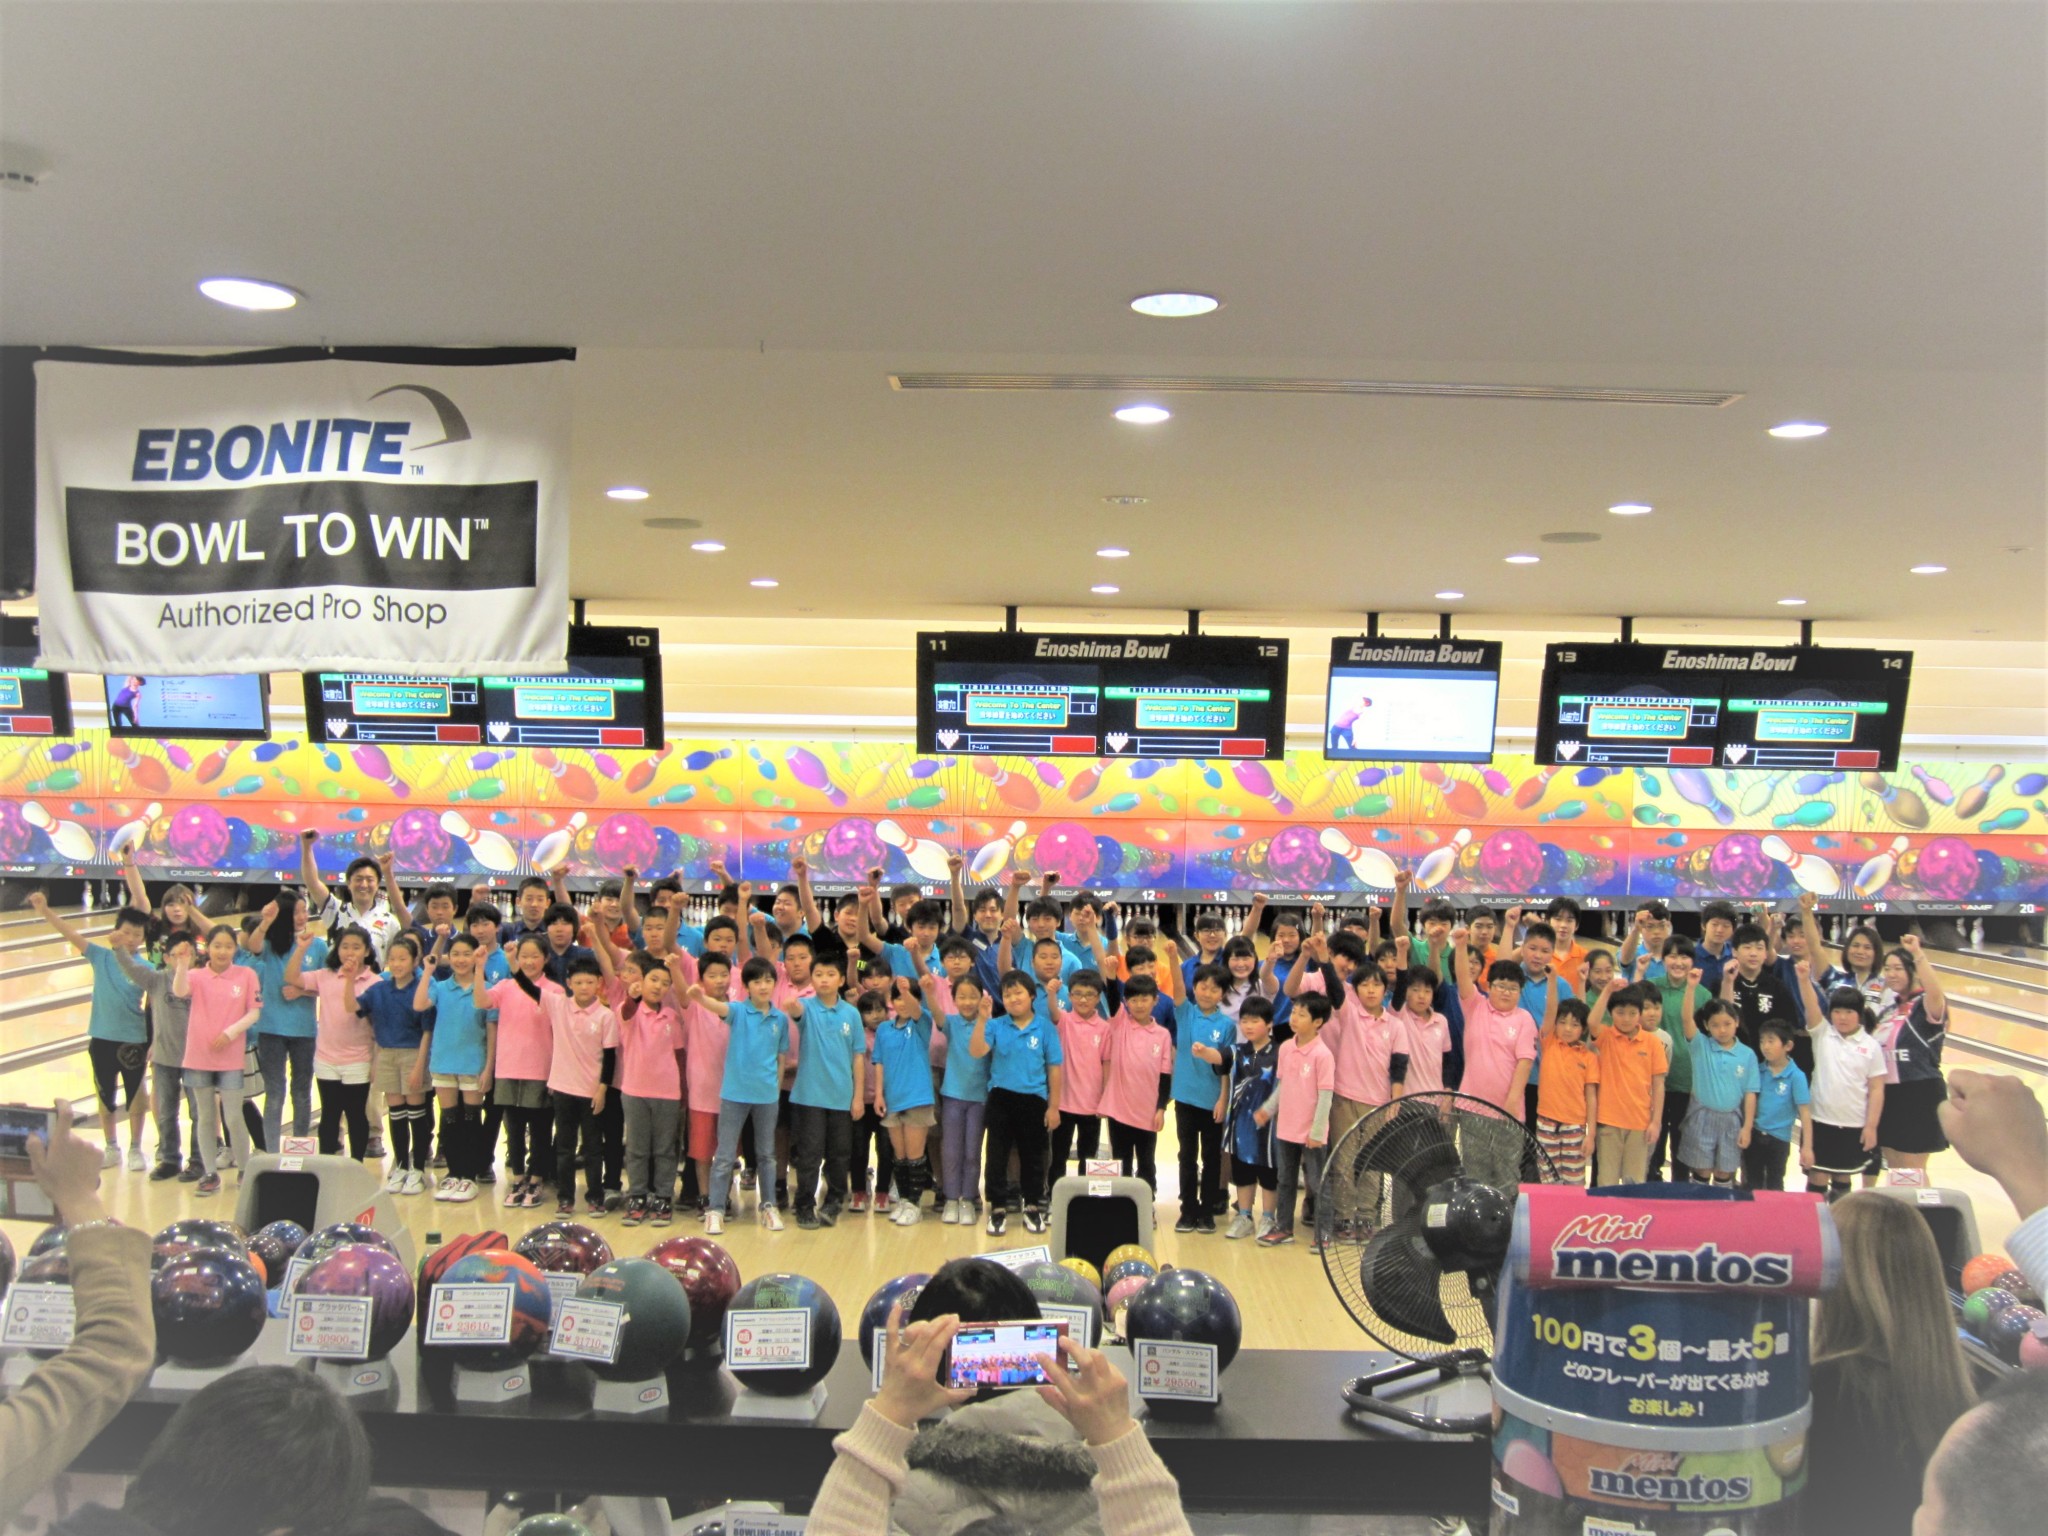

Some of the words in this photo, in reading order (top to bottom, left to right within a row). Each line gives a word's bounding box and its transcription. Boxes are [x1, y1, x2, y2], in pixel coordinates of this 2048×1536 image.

[132, 418, 411, 482] EBONITE
[116, 519, 265, 566] BOWL
[283, 512, 356, 558] TO
[370, 514, 470, 560] WIN
[158, 595, 314, 629] Authorized
[322, 593, 361, 620] Pro
[372, 595, 447, 629] Shop
[627, 635, 650, 646] 10
[929, 640, 947, 651] 11
[1035, 638, 1122, 658] Enoshima
[1123, 639, 1171, 659] Bowl
[1258, 645, 1278, 657] 12
[1349, 642, 1436, 663] Enoshima
[1437, 644, 1484, 664] Bowl
[1557, 652, 1577, 663] 13
[1663, 650, 1750, 670] Enoshima
[1751, 652, 1798, 671] Bowl
[1882, 658, 1903, 669] 14
[66, 866, 73, 876] 2
[275, 871, 283, 881] 4
[488, 876, 495, 886] 6
[704, 881, 712, 891] 8
[770, 882, 778, 893] 9
[920, 885, 934, 896] 10
[1142, 890, 1155, 901] 12
[1214, 890, 1228, 901] 13
[1365, 894, 1378, 904] 14
[1586, 897, 1600, 908] 16
[1874, 902, 1887, 912] 19
[2019, 903, 2035, 913] 20
[1552, 1214, 1653, 1250] Mini
[1551, 1242, 1792, 1288] mentos
[457, 1321, 490, 1332] 23610
[756, 1346, 789, 1356] 31170
[1562, 1360, 1770, 1392] どのフレーバーが出てくるかは
[1588, 1465, 1752, 1502] mentos
